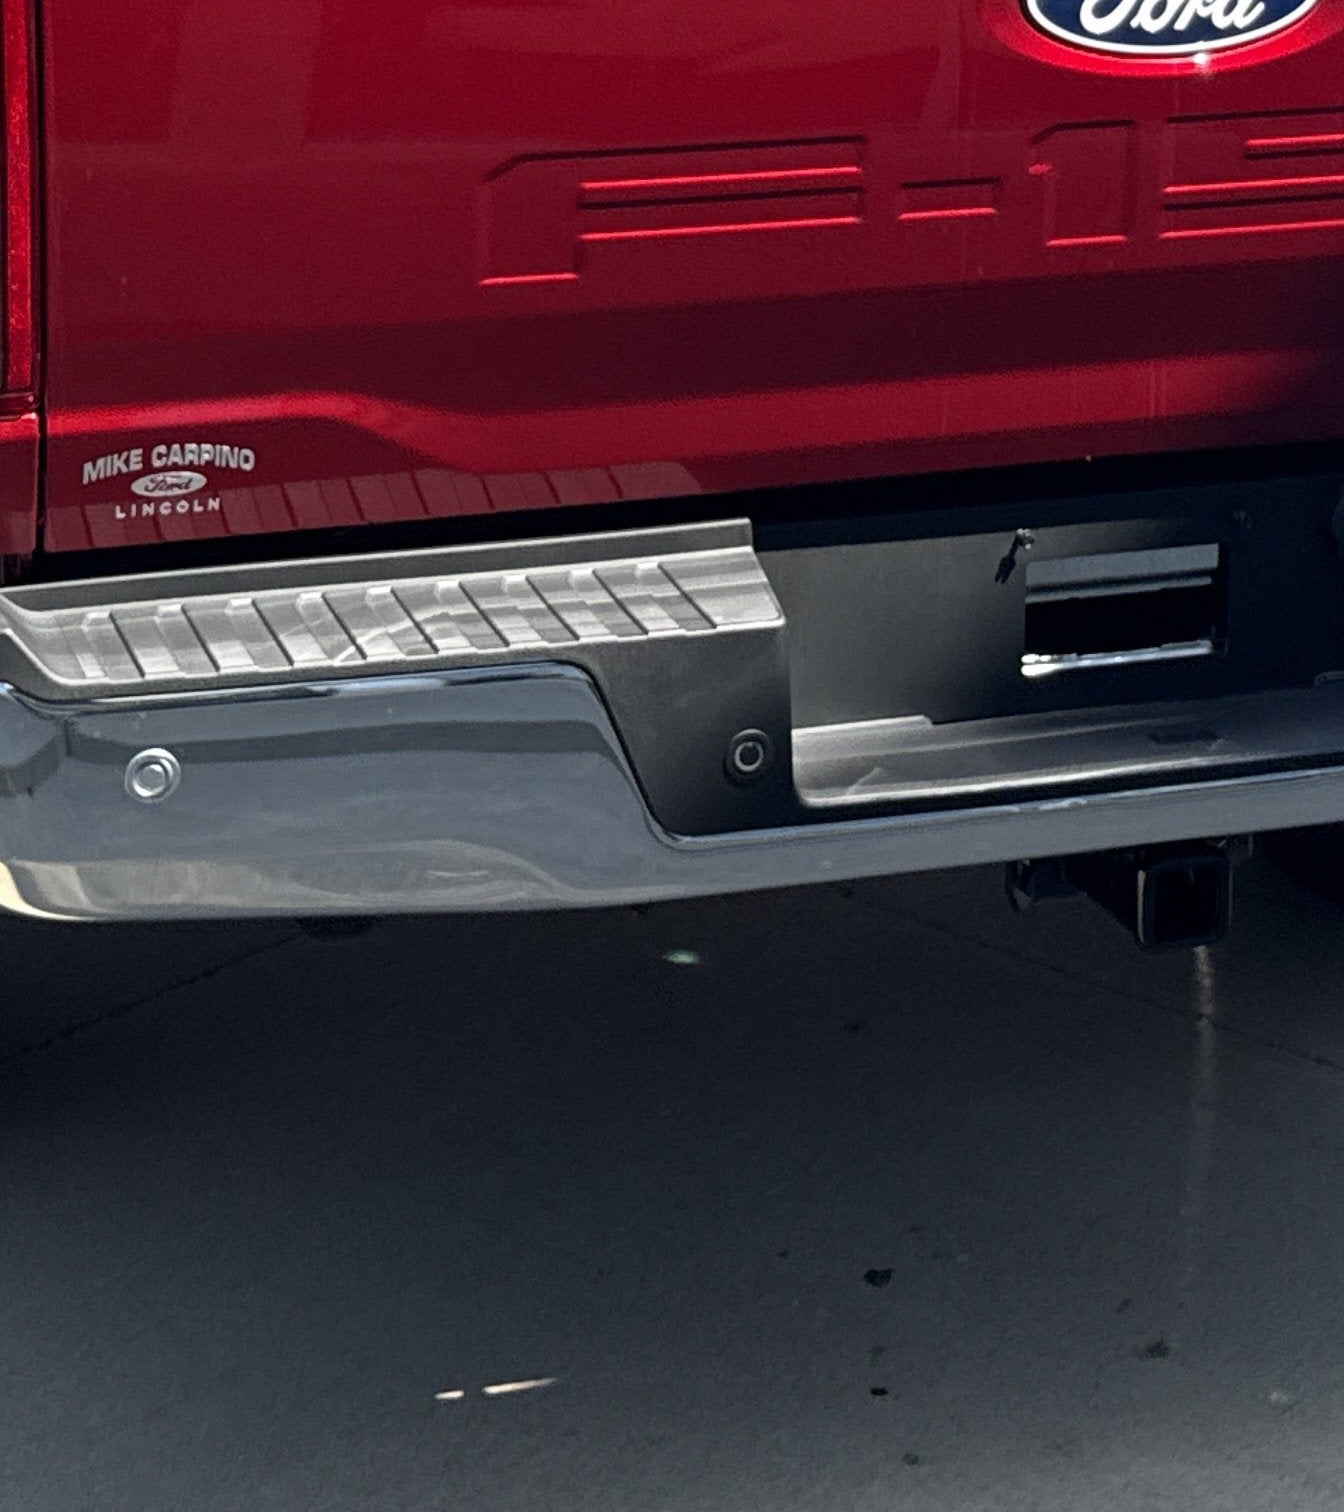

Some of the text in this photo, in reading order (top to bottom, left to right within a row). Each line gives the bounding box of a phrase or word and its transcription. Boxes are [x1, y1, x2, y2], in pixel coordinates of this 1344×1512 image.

[82, 443, 256, 485] MIKE CARPINO
[114, 497, 222, 519] LINCOLN
